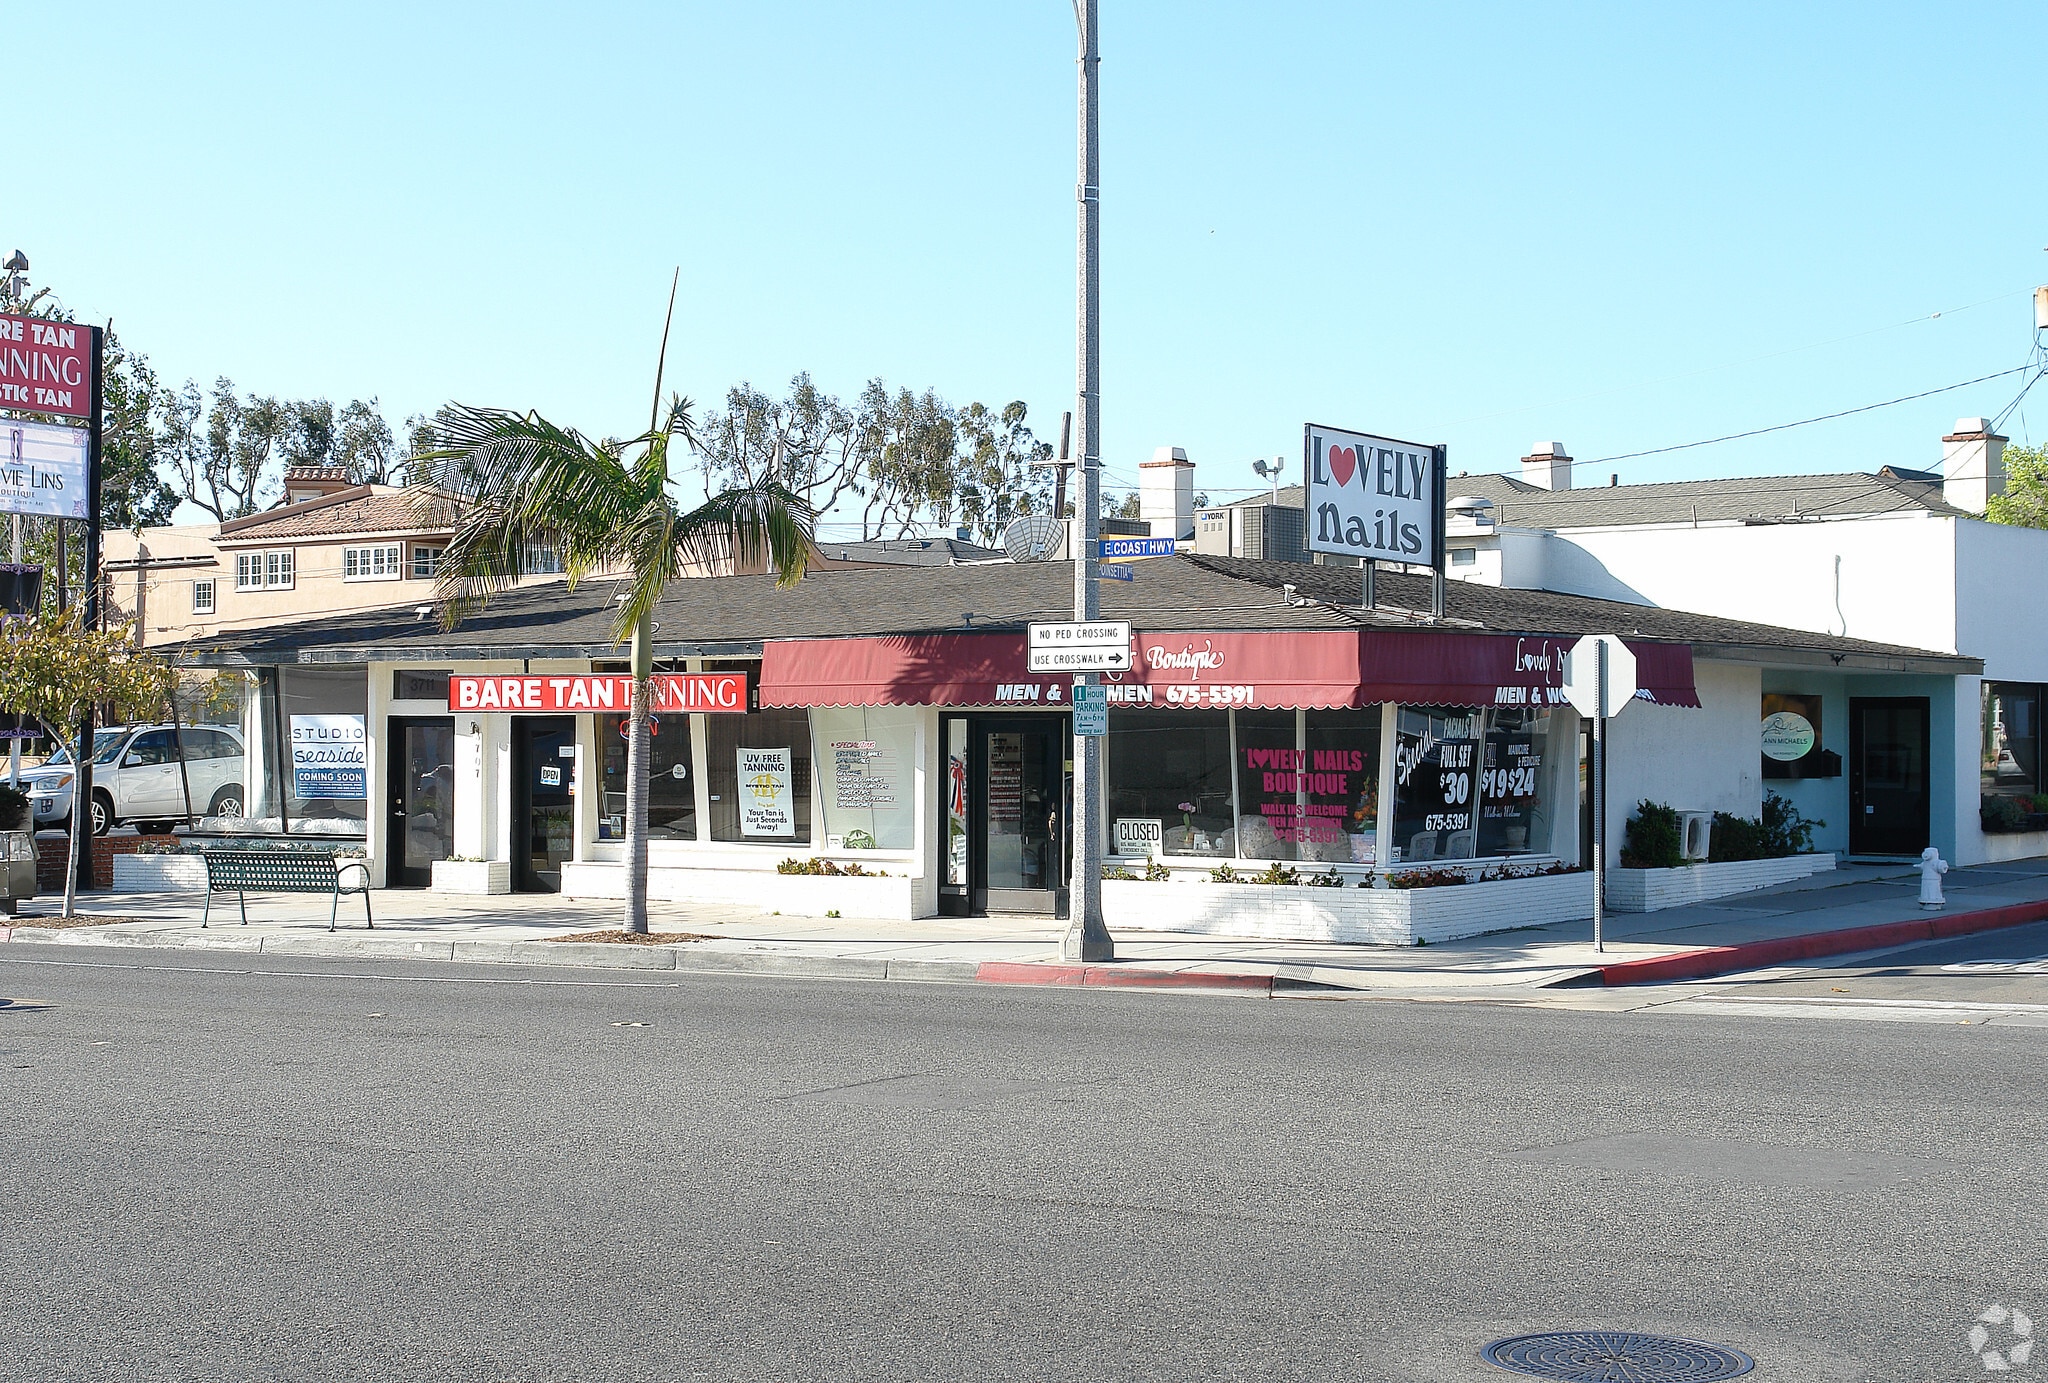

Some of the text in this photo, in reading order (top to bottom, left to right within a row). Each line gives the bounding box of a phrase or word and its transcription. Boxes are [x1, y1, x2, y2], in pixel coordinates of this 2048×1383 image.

[0, 318, 76, 350] RE TAN
[0, 382, 72, 408] TIC TAN
[1207, 512, 1225, 520] YORK
[1317, 501, 1422, 555] nails
[1150, 539, 1174, 554] HWY
[1099, 563, 1128, 579] OINSETTIA
[1039, 628, 1118, 639] NO PED CROSSING
[1034, 653, 1104, 665] USE CROSSWALK
[1146, 638, 1225, 681] Boutique
[409, 678, 435, 692] 3711
[458, 678, 737, 708] BARE TAN TNNING
[995, 683, 1254, 704] MEN & MEN 675-5391
[1077, 687, 1104, 700] 1 HOUR
[1494, 686, 1527, 704] MEN
[1531, 687, 1542, 704] &
[1075, 702, 1105, 712] PARKING
[293, 728, 363, 739] STUDIO
[620, 719, 658, 736] ON
[1443, 717, 1470, 739] FACIALS
[1396, 713, 1434, 787] Special
[1440, 744, 1472, 768] FULL SET
[746, 754, 782, 763] UV FREE
[1313, 750, 1363, 772] NAILS
[542, 769, 559, 780] OPEN
[743, 763, 785, 772] TANNING
[298, 772, 362, 781] COMING SOON
[1262, 771, 1348, 796] BOUTIQUE
[1481, 768, 1508, 798] $19
[1508, 767, 1535, 797] $24
[1439, 772, 1469, 804] $30
[748, 808, 764, 816] Your
[778, 808, 784, 817] is
[1260, 803, 1348, 816] WALK INS WELCOME
[760, 815, 788, 823] Seconds
[1267, 816, 1342, 829] MEN AND WOMEN
[1425, 812, 1470, 831] 675-5391
[756, 823, 778, 832] Away!
[1120, 822, 1160, 841] CLOSED
[1284, 829, 1338, 844] 675-5391
